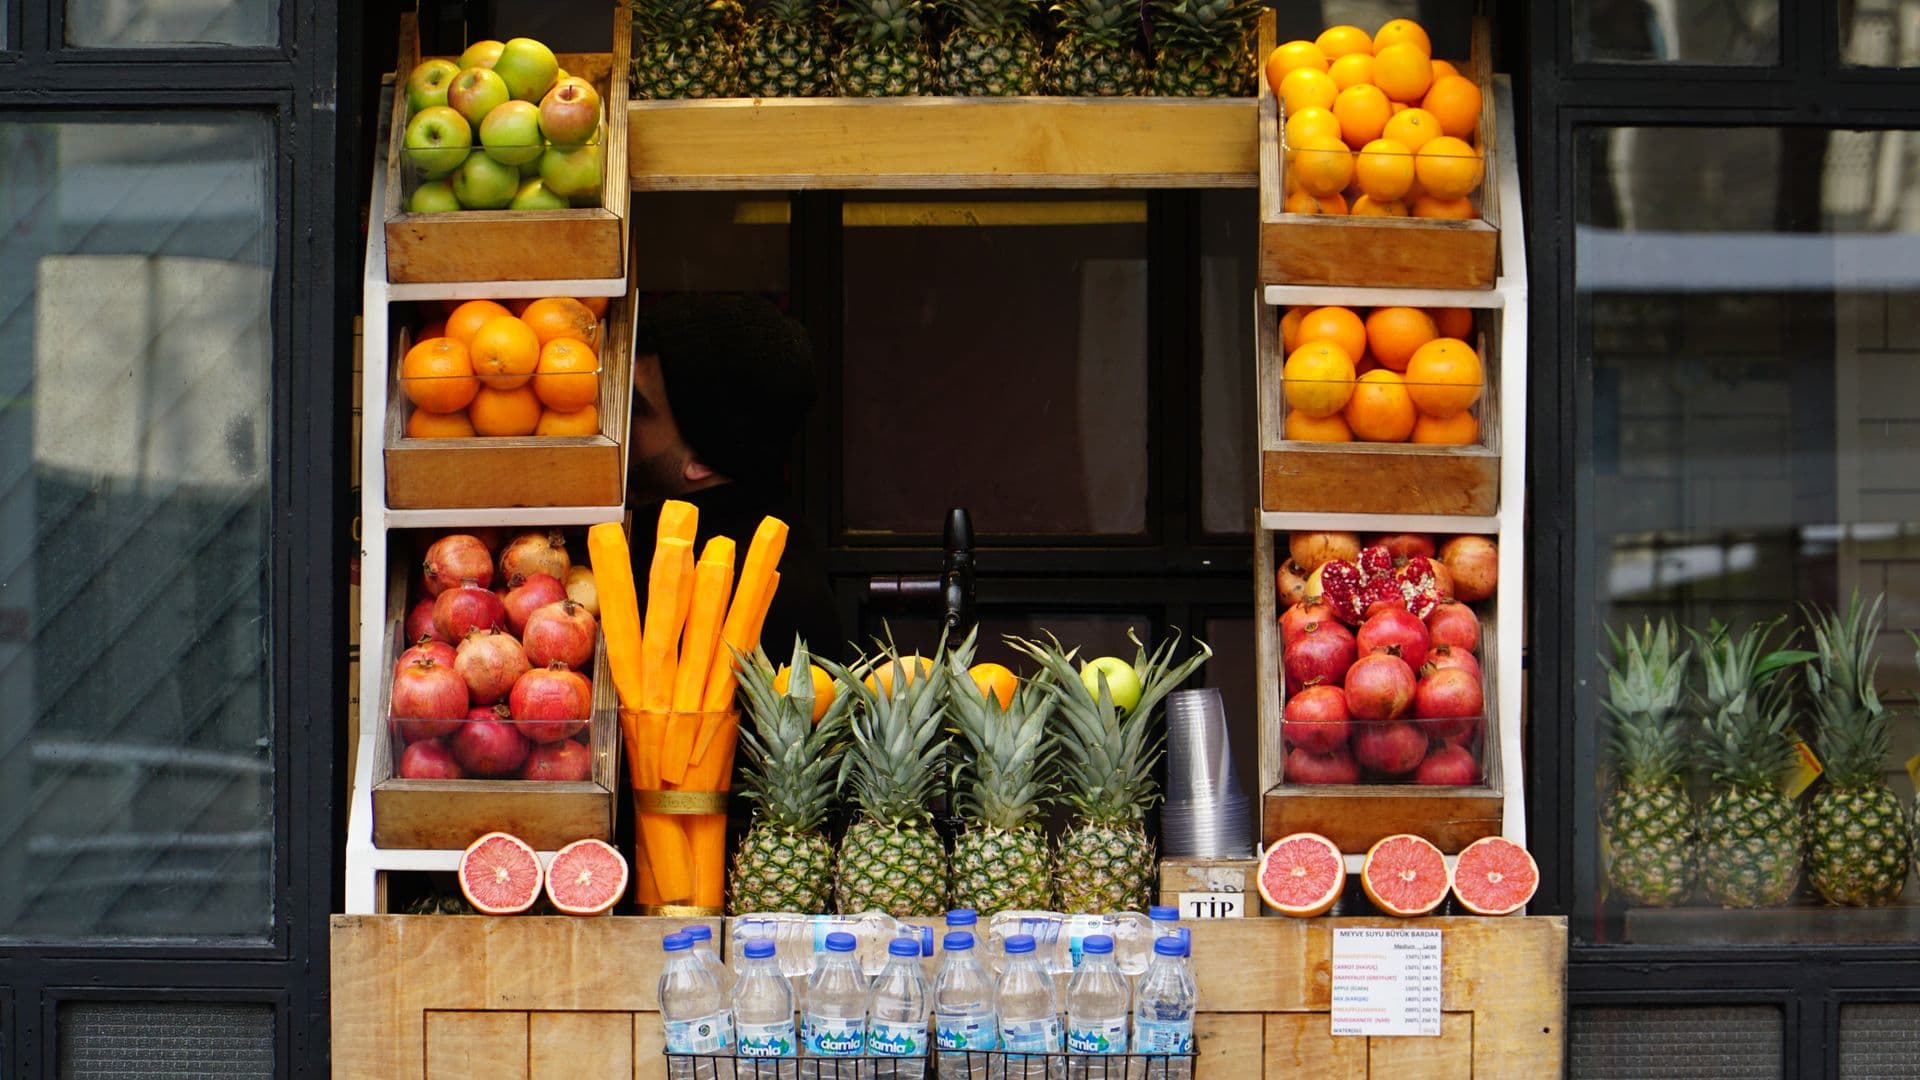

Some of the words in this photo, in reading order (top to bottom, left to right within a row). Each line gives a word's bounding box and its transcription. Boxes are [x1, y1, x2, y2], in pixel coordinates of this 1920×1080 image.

[1339, 930, 1363, 938] MEYVE
[1386, 929, 1409, 938] BÜYÜK
[1411, 930, 1439, 938] BARDAK
[741, 1041, 781, 1056] damla
[820, 1037, 861, 1050] damla
[869, 1036, 906, 1053] damla
